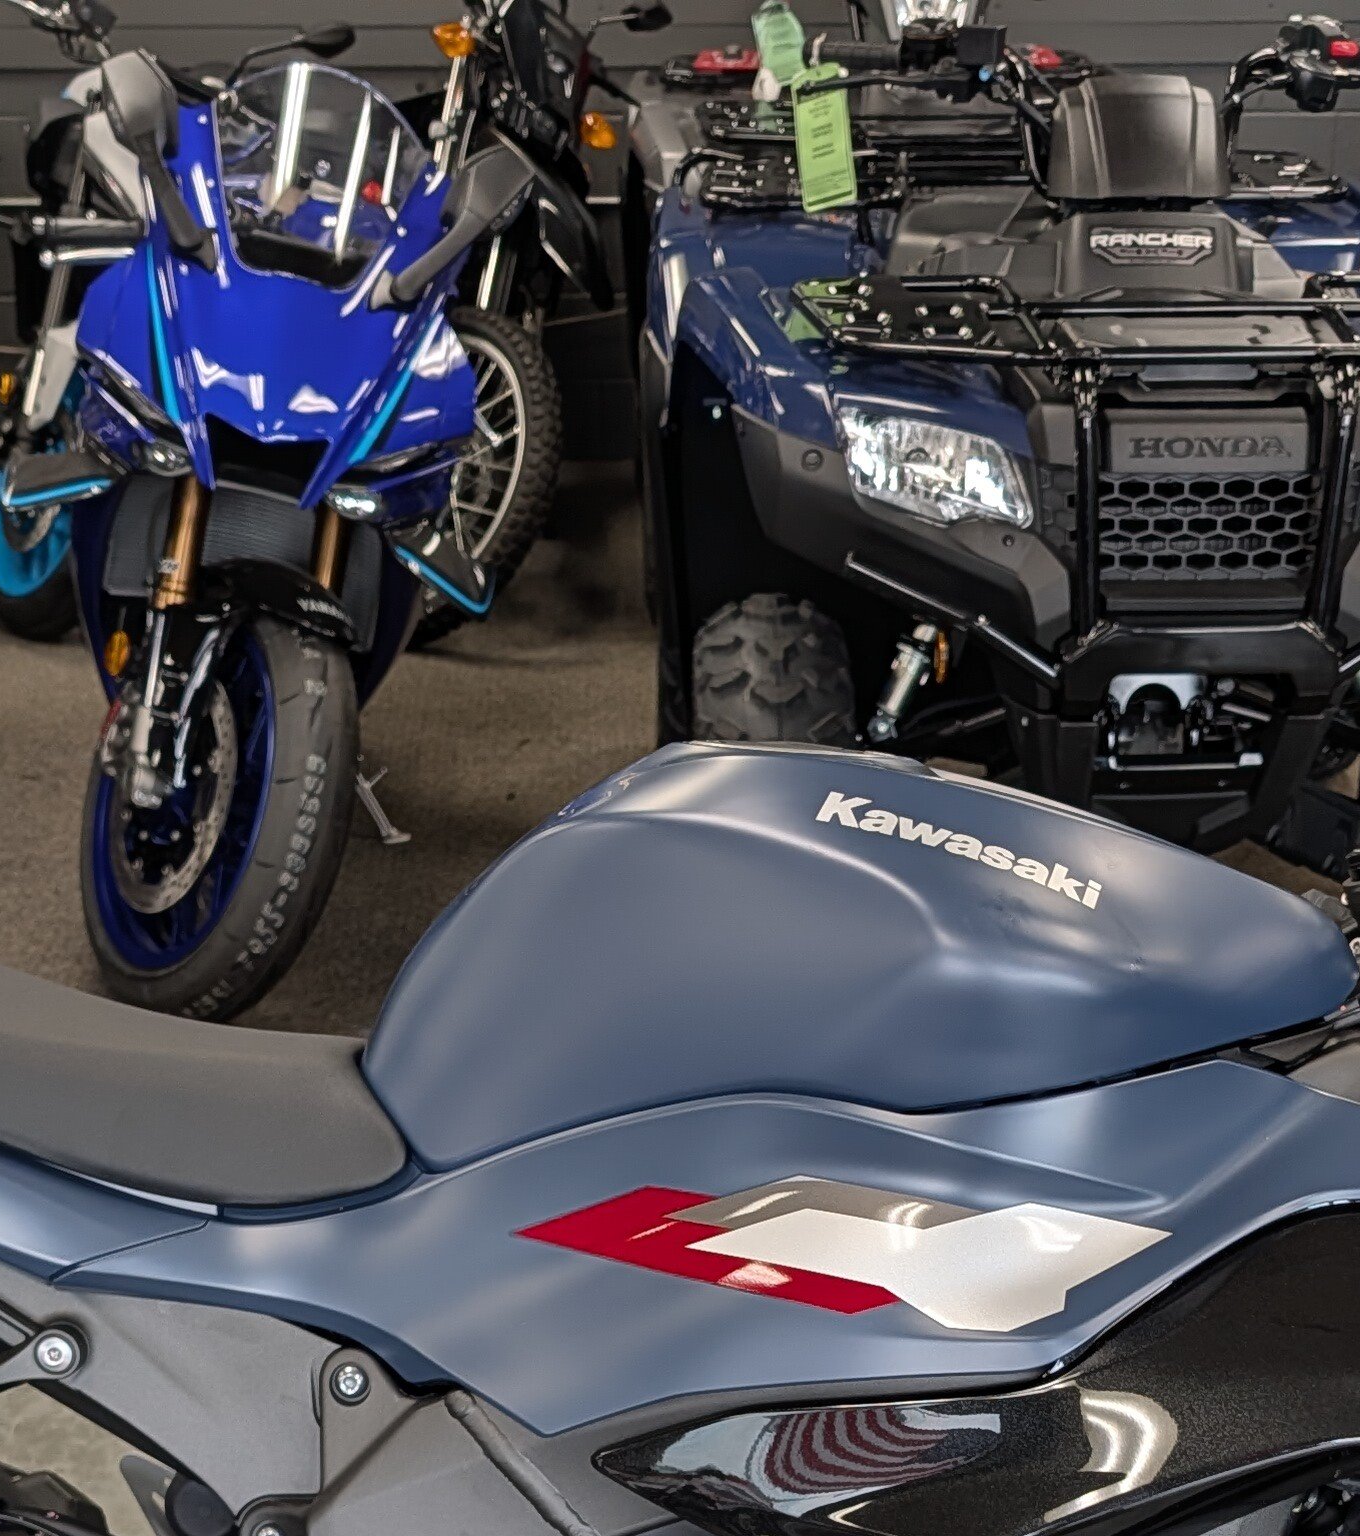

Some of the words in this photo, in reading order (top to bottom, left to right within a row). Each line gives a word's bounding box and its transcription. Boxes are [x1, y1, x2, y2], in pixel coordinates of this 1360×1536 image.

[1090, 233, 1213, 249] RANCHER
[1129, 436, 1291, 459] HONDA
[815, 791, 1103, 909] Kawasaki
